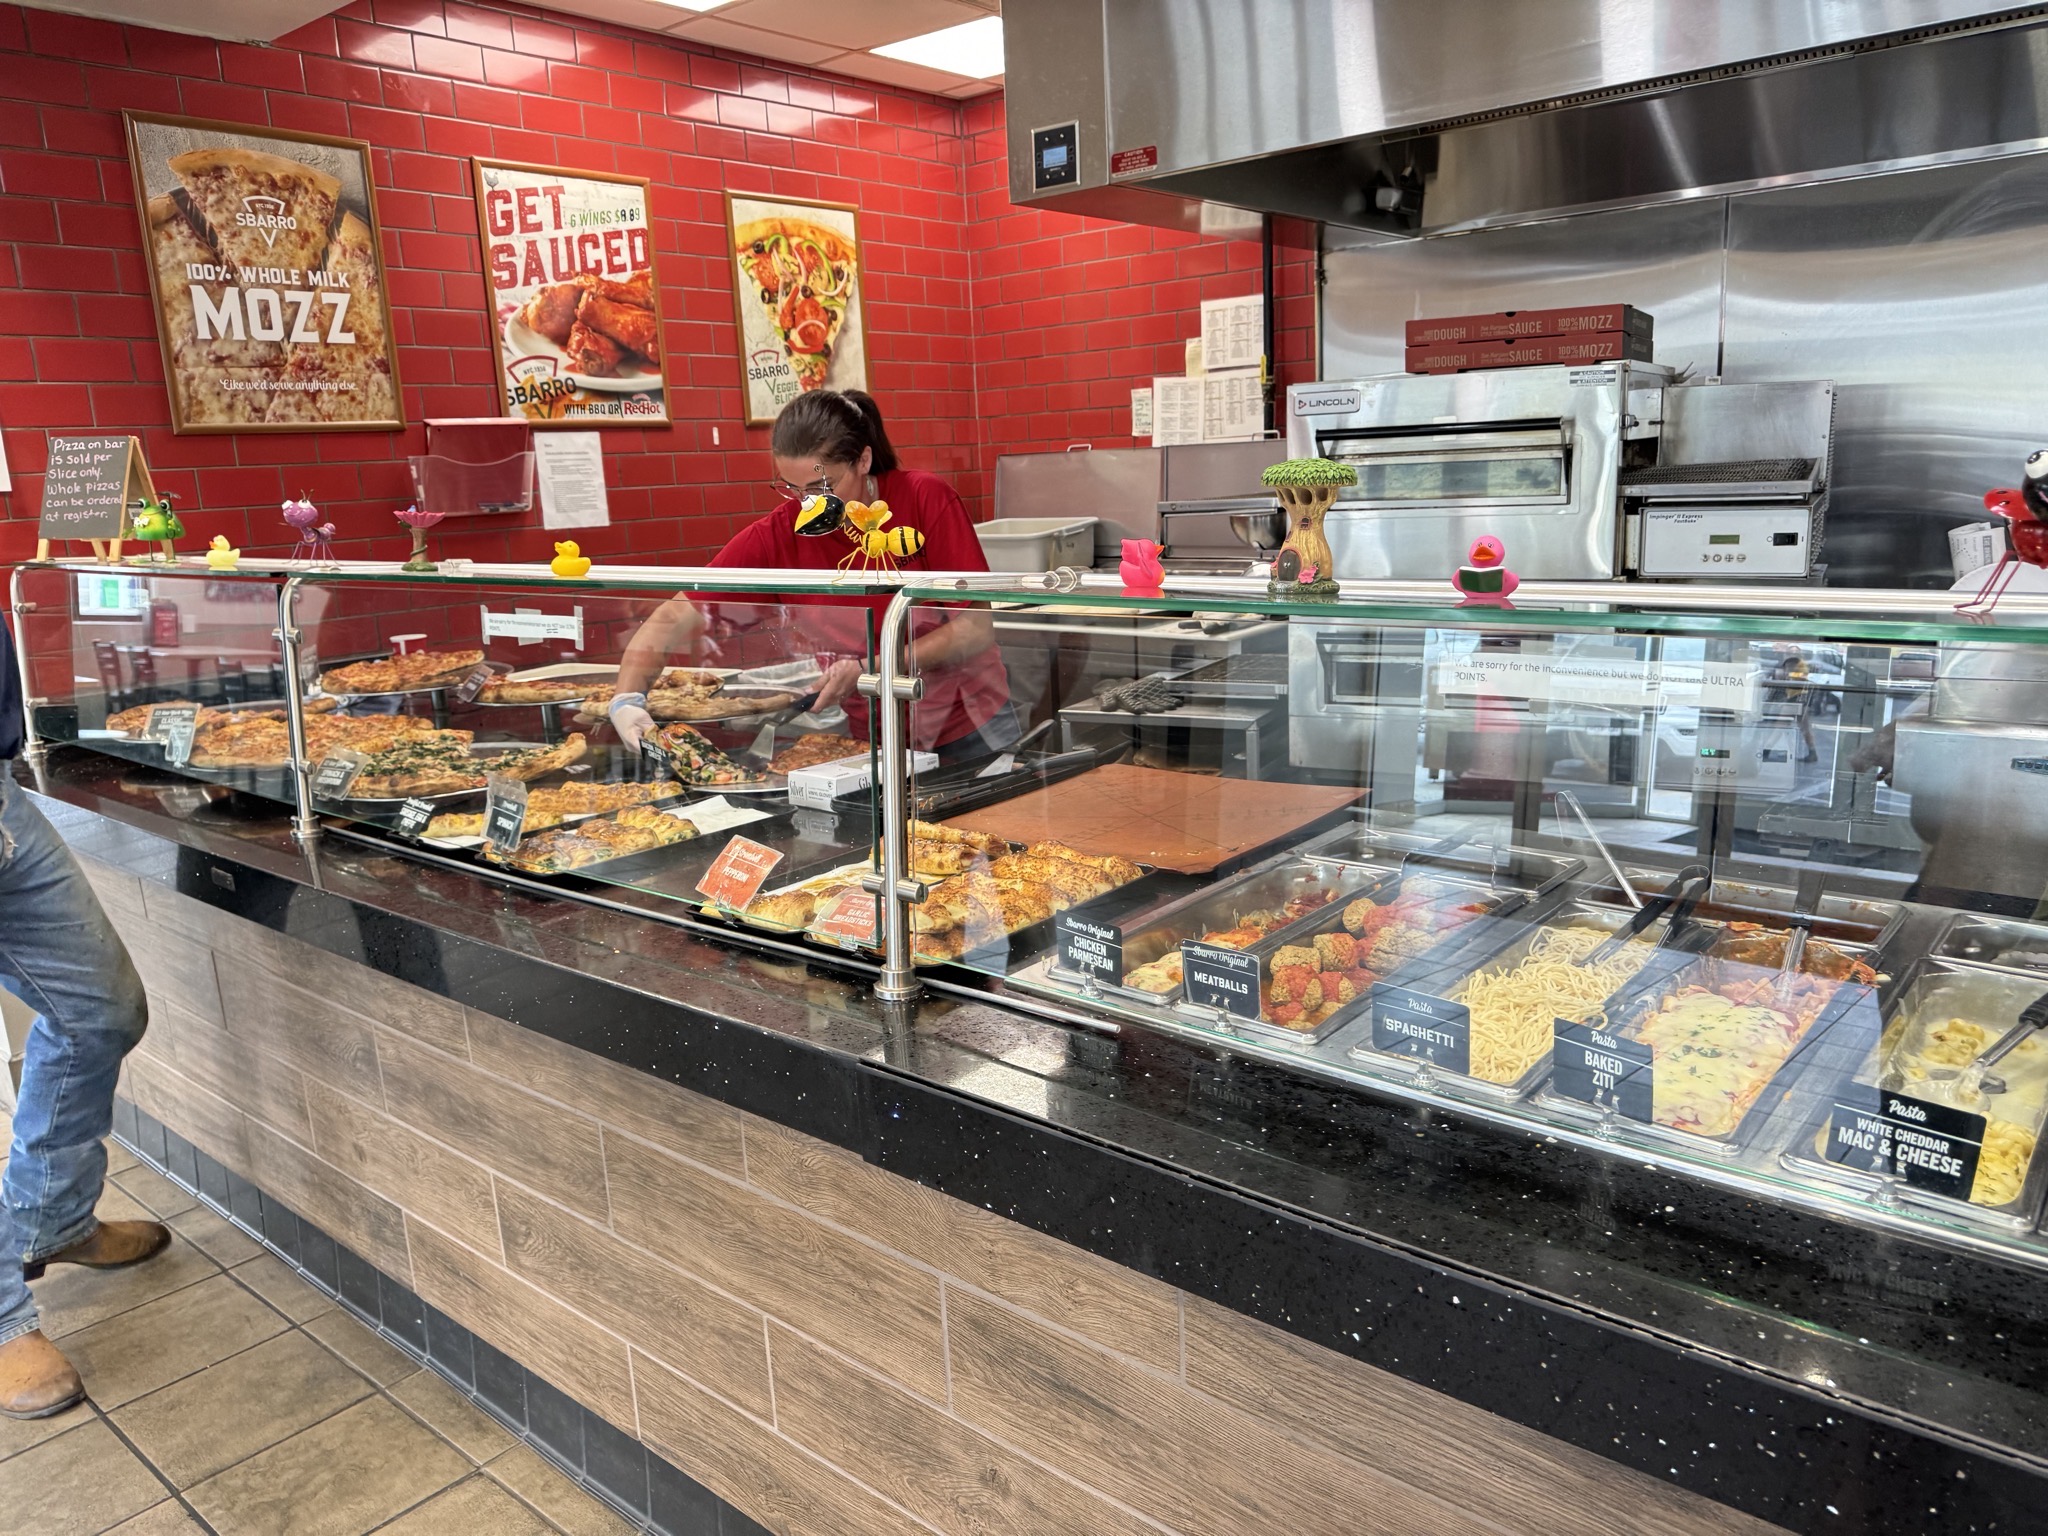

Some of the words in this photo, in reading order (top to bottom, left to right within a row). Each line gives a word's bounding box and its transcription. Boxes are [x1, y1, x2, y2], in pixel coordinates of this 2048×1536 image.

[486, 185, 566, 237] GET
[570, 213, 577, 228] 6
[579, 210, 612, 227] WINGS
[235, 212, 297, 231] SBARRO
[489, 227, 652, 291] SAUCED
[185, 262, 232, 282] 100%
[240, 266, 302, 285] WHOLE
[308, 270, 350, 288] MILK
[189, 284, 356, 344] MOZZ
[1558, 317, 1578, 328] 100%
[1579, 315, 1613, 330] MOZZ
[1434, 327, 1466, 341] DOUGH
[1508, 321, 1543, 335] SAUCE
[1508, 349, 1543, 363] SAUCE
[1558, 345, 1578, 355] 100%
[1580, 343, 1613, 358] MOZZ
[1434, 355, 1467, 368] DOUGH
[747, 364, 790, 380] SBARRO
[219, 378, 249, 391] Like
[268, 381, 294, 391] serve
[295, 378, 338, 393] anything
[507, 377, 577, 407] SBARRO
[765, 378, 799, 396] VEGGIE
[564, 403, 586, 415] WITH
[588, 403, 606, 415] BBQ
[608, 403, 620, 415] OR
[624, 400, 661, 415] RedHot
[775, 392, 798, 405] SLIC
[1309, 397, 1355, 408] LINCOLN
[54, 438, 86, 453] Pizza
[88, 442, 101, 450] on
[105, 439, 126, 449] bar
[51, 455, 63, 466] is
[93, 454, 112, 465] per
[86, 481, 121, 494] pizzas
[46, 499, 68, 508] can
[71, 496, 84, 506] be
[45, 512, 58, 522] at
[1470, 661, 1485, 669] are
[1486, 662, 1508, 672] sorry
[1509, 662, 1523, 672] for
[1525, 663, 1540, 673] the
[1542, 664, 1609, 678] inconvenience
[1611, 668, 1628, 679] but
[1630, 672, 1645, 680] we
[1647, 671, 1659, 681] do
[1711, 676, 1744, 688] ULTRA
[832, 914, 873, 927] BREADSTICKS
[847, 909, 870, 918] GARLIC
[1066, 917, 1087, 931] Sbarro
[1088, 923, 1114, 940] Original
[1074, 935, 1107, 956] CHICKEN
[1068, 945, 1113, 972] PARMESEAN
[1192, 945, 1218, 959] Sbarro
[1218, 952, 1249, 968] Original
[1194, 971, 1248, 994] MEATBALLS
[1408, 997, 1433, 1014] Pasta
[1385, 1017, 1454, 1049] SPAGHETTI
[1591, 1030, 1617, 1050] Pasta
[1584, 1050, 1623, 1076] BAKED
[1593, 1069, 1614, 1091] ZITI
[1889, 1099, 1927, 1122] Pasta
[1857, 1117, 1893, 1138] WHITE
[1894, 1128, 1950, 1155] CHEDDAR
[1837, 1126, 1876, 1151] MAC
[1878, 1138, 1892, 1158] &
[1896, 1143, 1964, 1178] CHEESE
